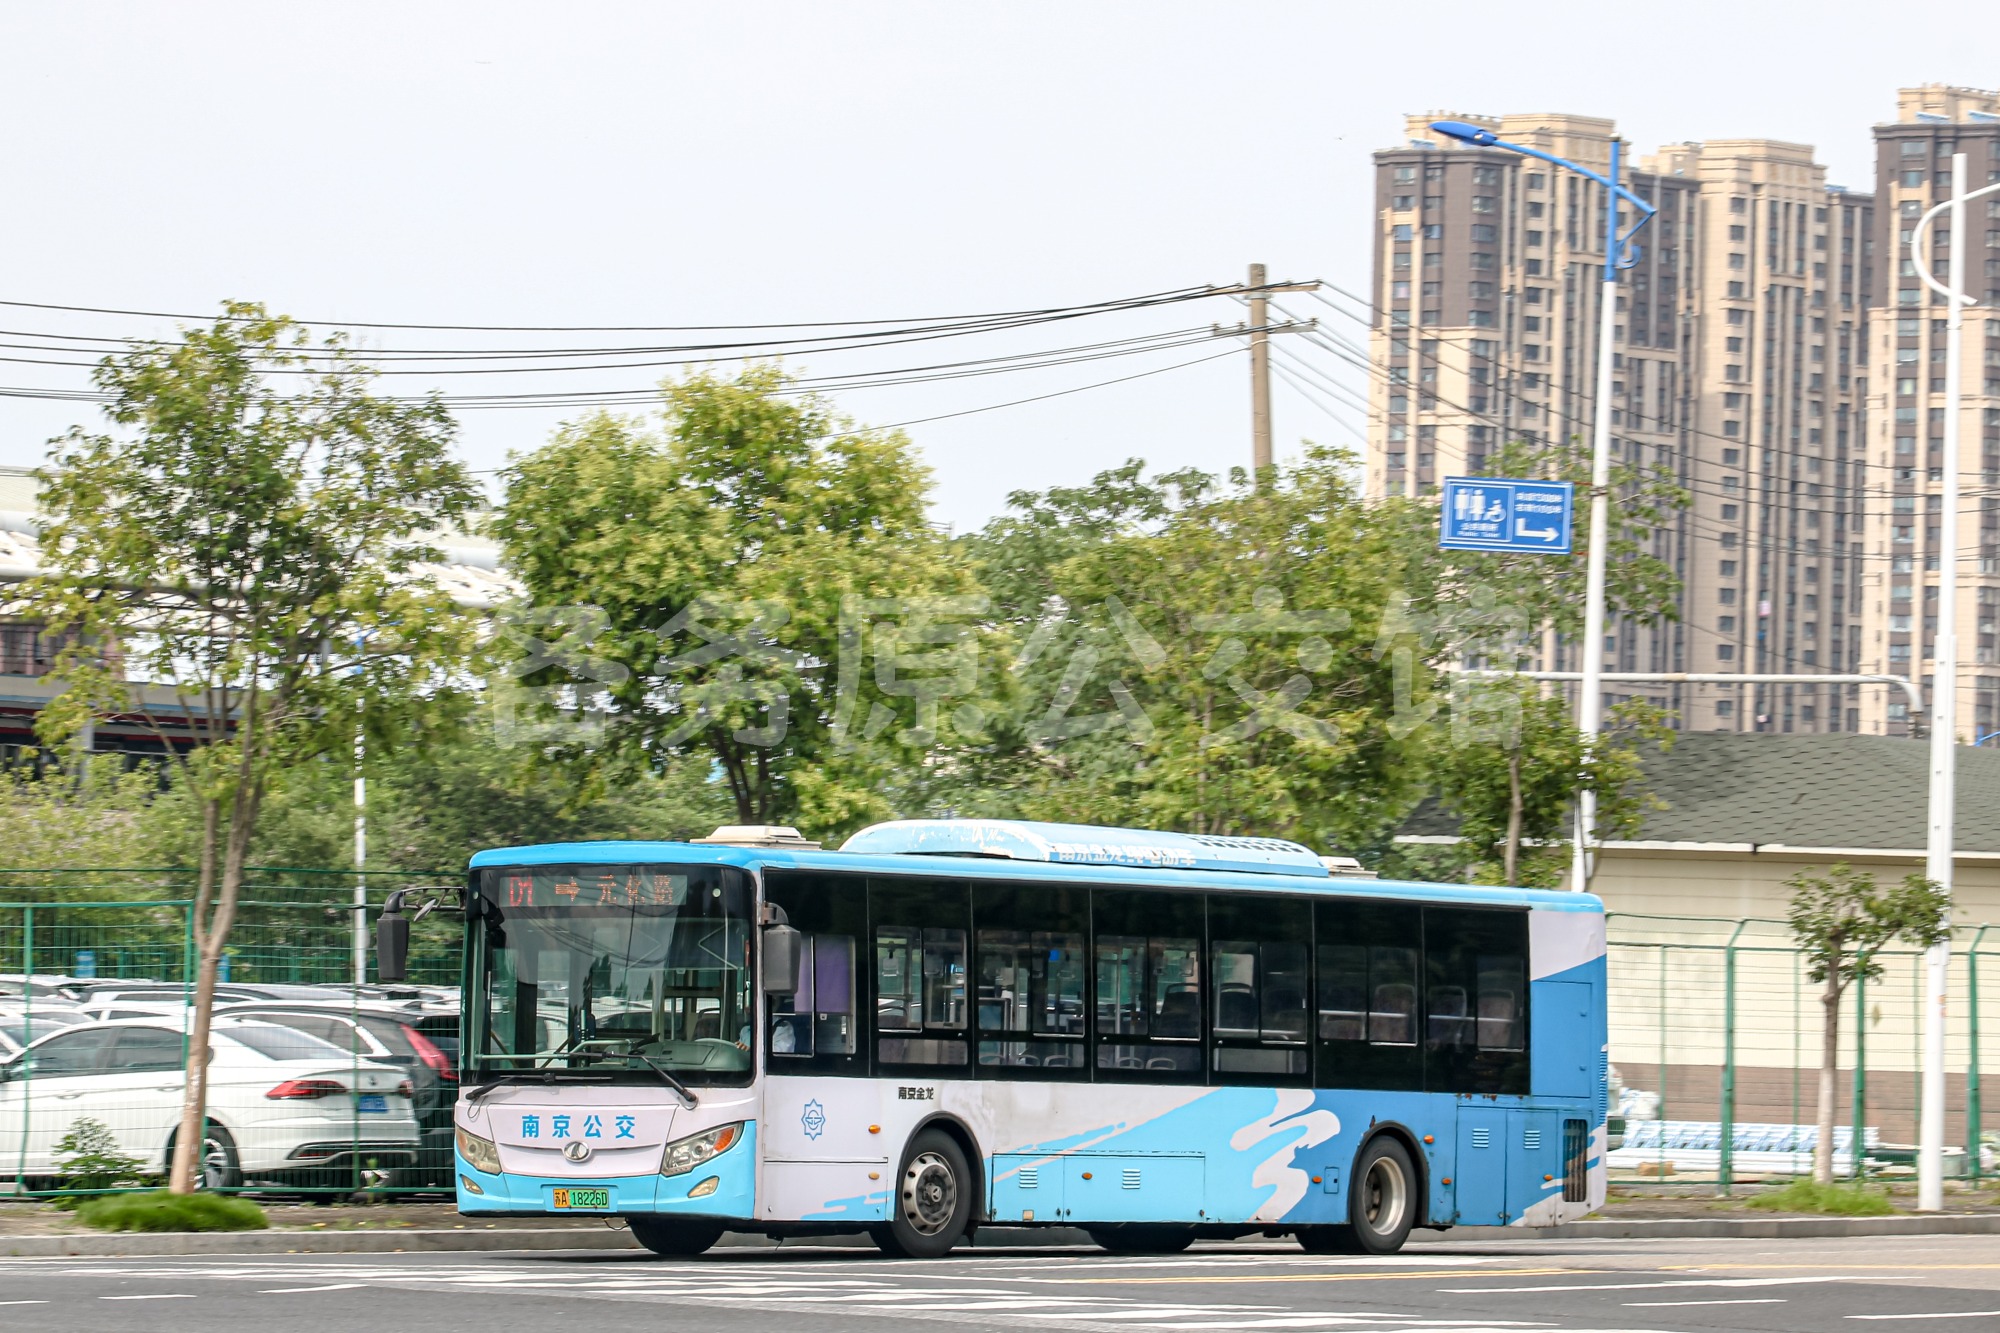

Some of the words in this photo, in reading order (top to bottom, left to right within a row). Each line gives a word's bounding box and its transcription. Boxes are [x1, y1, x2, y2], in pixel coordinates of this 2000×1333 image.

[898, 1086, 935, 1100] 南京金龙
[521, 1114, 636, 1139] 南京公交
